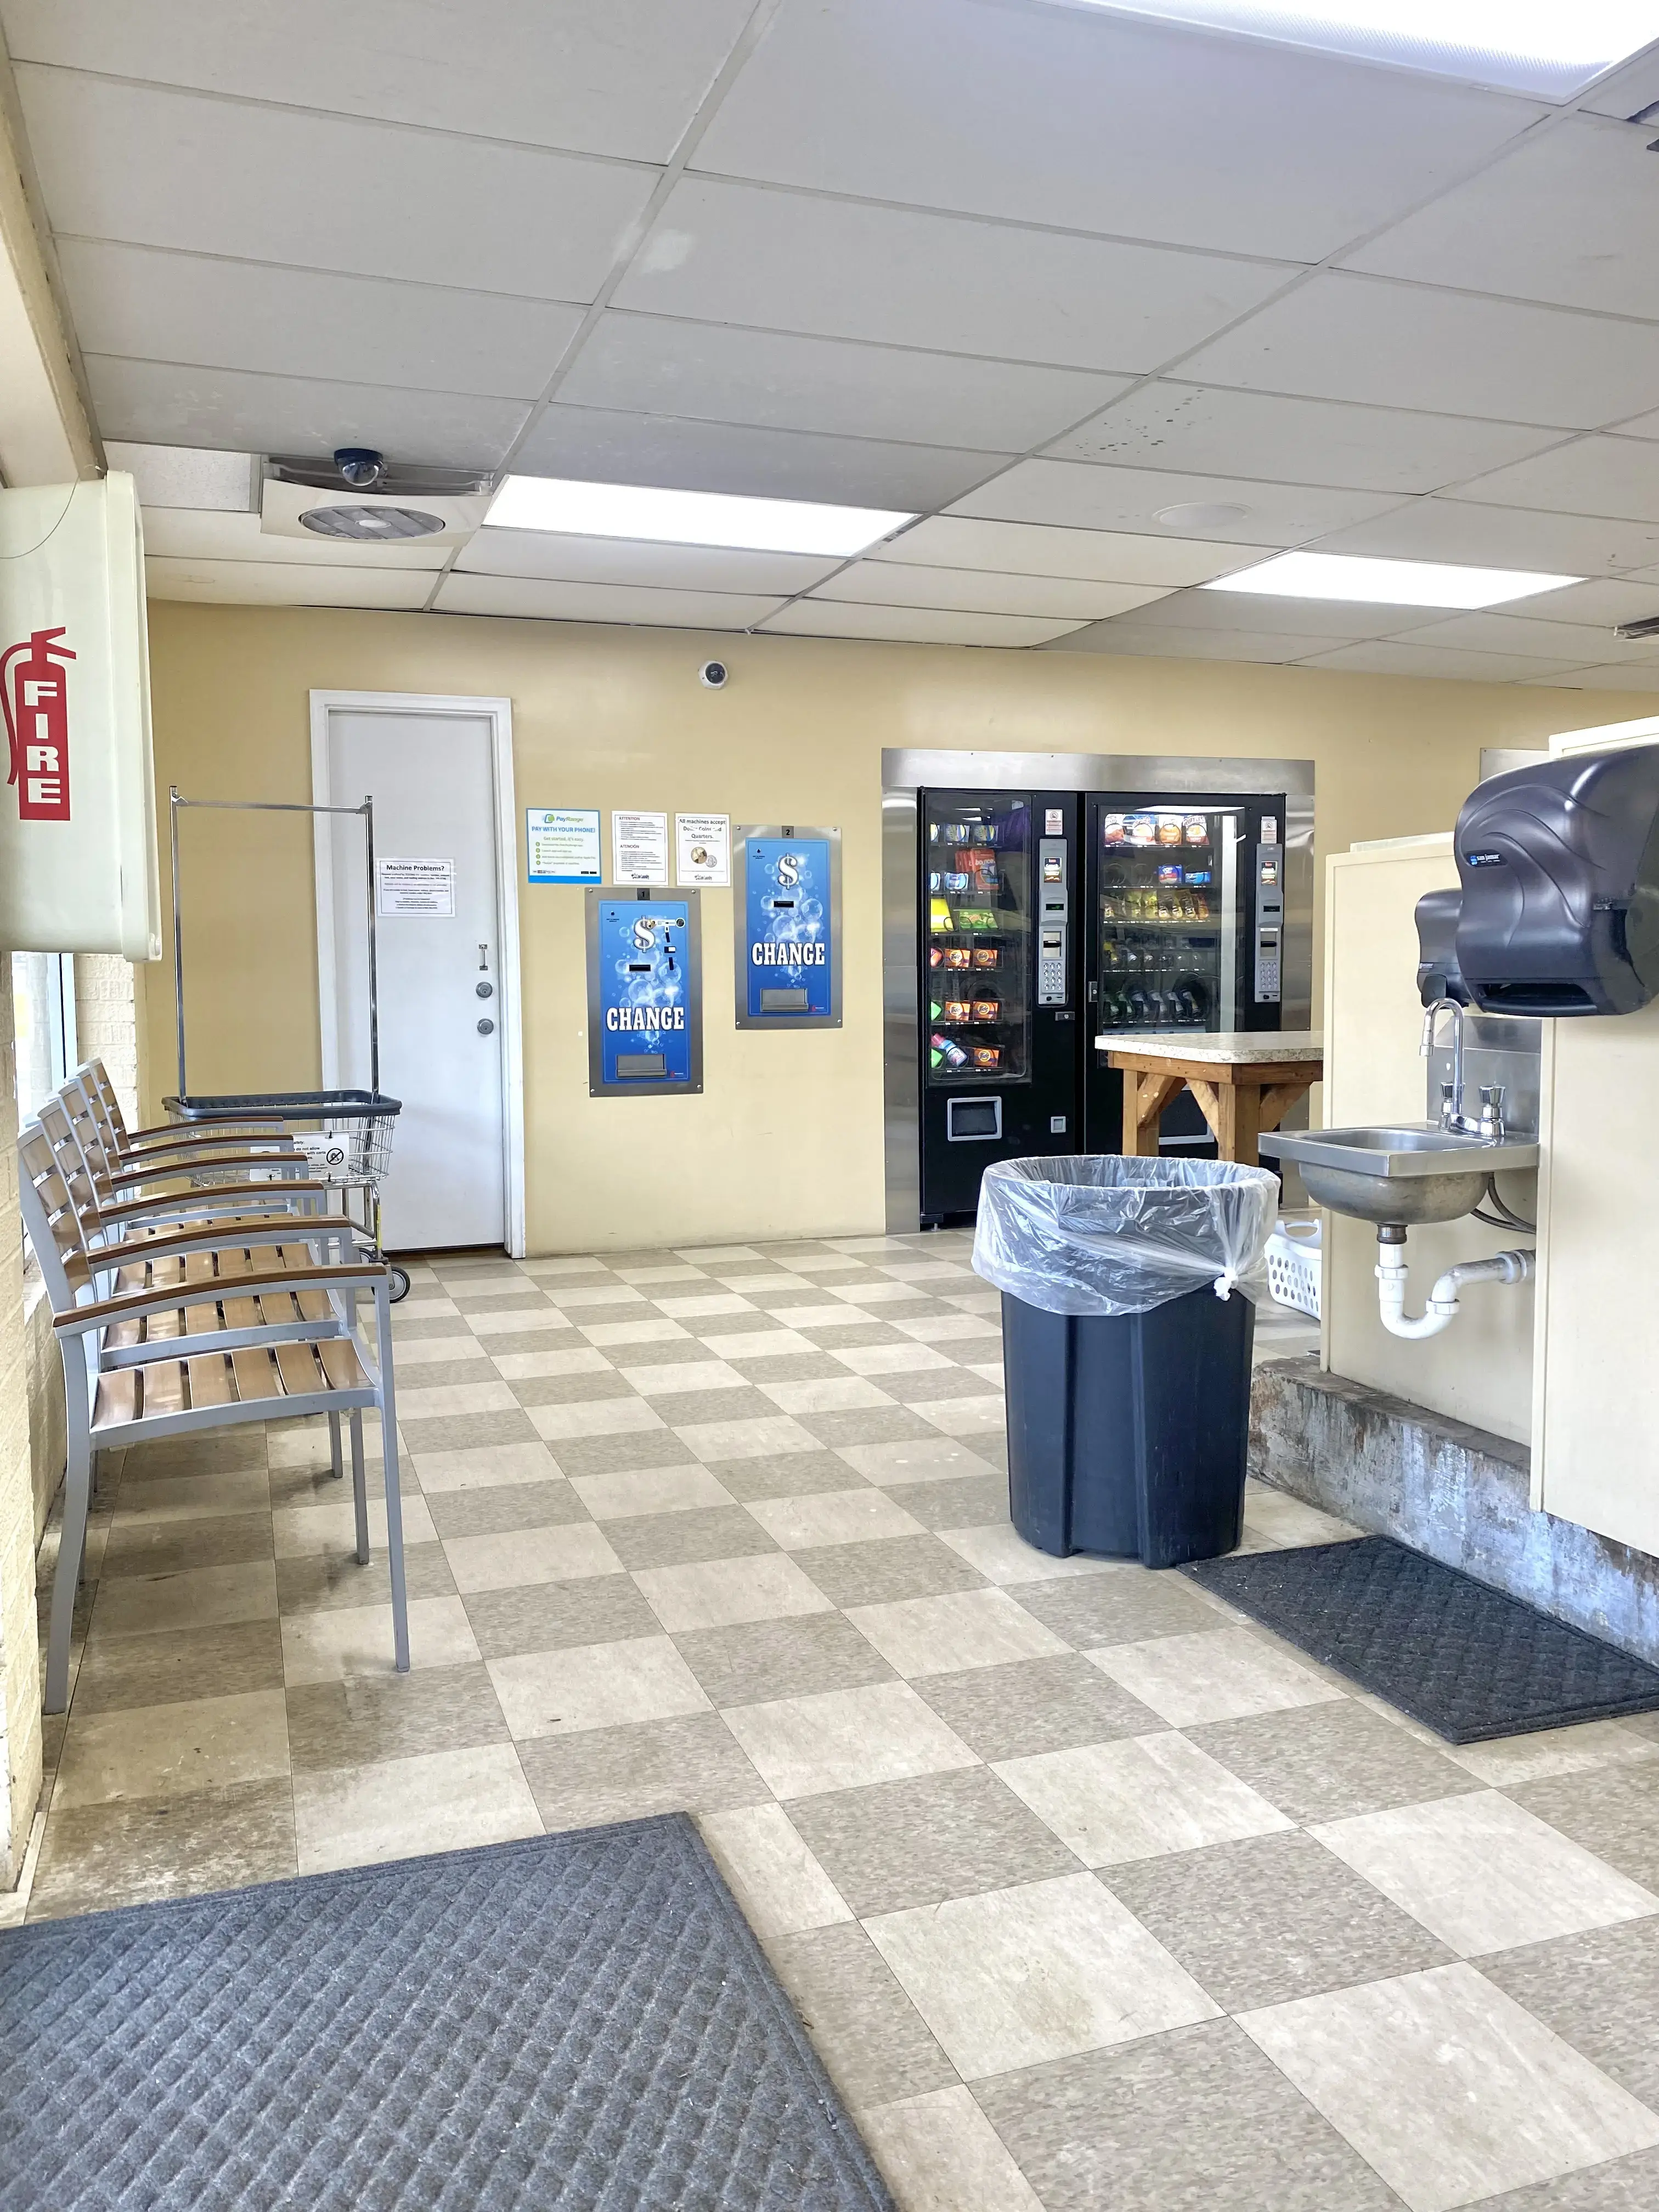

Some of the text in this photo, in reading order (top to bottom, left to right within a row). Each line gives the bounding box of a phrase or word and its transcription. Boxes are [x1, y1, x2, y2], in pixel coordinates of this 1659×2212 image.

[24, 680, 61, 804] FIRE
[752, 943, 825, 966] CHANGE
[606, 1006, 685, 1032] CHANGE
